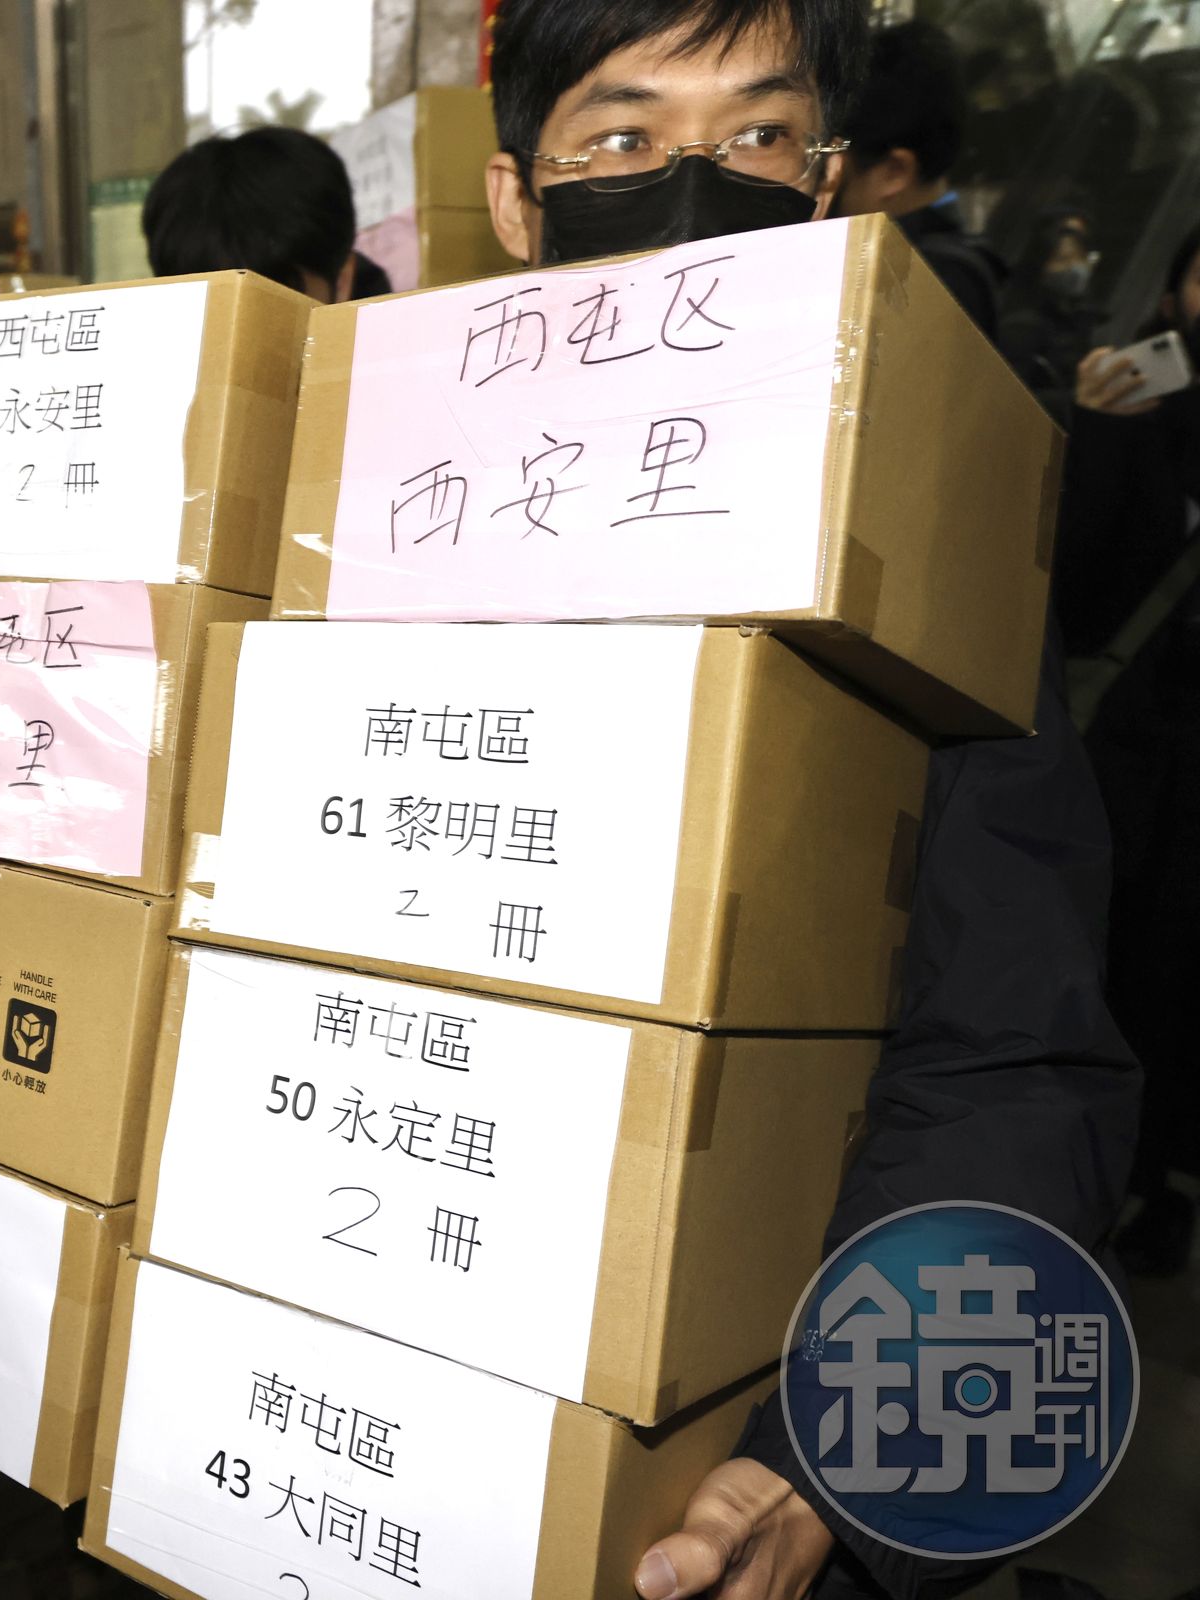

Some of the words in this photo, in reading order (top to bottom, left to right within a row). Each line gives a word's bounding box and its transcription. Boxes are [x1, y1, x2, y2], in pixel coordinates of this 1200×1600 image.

[460, 255, 736, 388] 西屯区
[15, 464, 36, 502] 2
[63, 462, 99, 508] 冊
[390, 417, 731, 553] 西安里
[364, 702, 535, 764] 南屯區
[320, 796, 367, 838] 61
[385, 795, 558, 865] 黎明里
[489, 901, 547, 963] 冊
[13, 982, 34, 997] WITH
[34, 987, 57, 1003] CARE
[20, 969, 54, 987] HANDLE
[314, 990, 477, 1072] 南屯區
[2, 1068, 47, 1094] 小心輕放
[266, 1074, 317, 1122] 50
[327, 1085, 496, 1178] 永定里
[322, 1187, 381, 1257] 2
[427, 1206, 482, 1273] 冊
[248, 1370, 401, 1478] 南屯區
[204, 1450, 252, 1499] 43
[264, 1475, 422, 1588] 大同里
